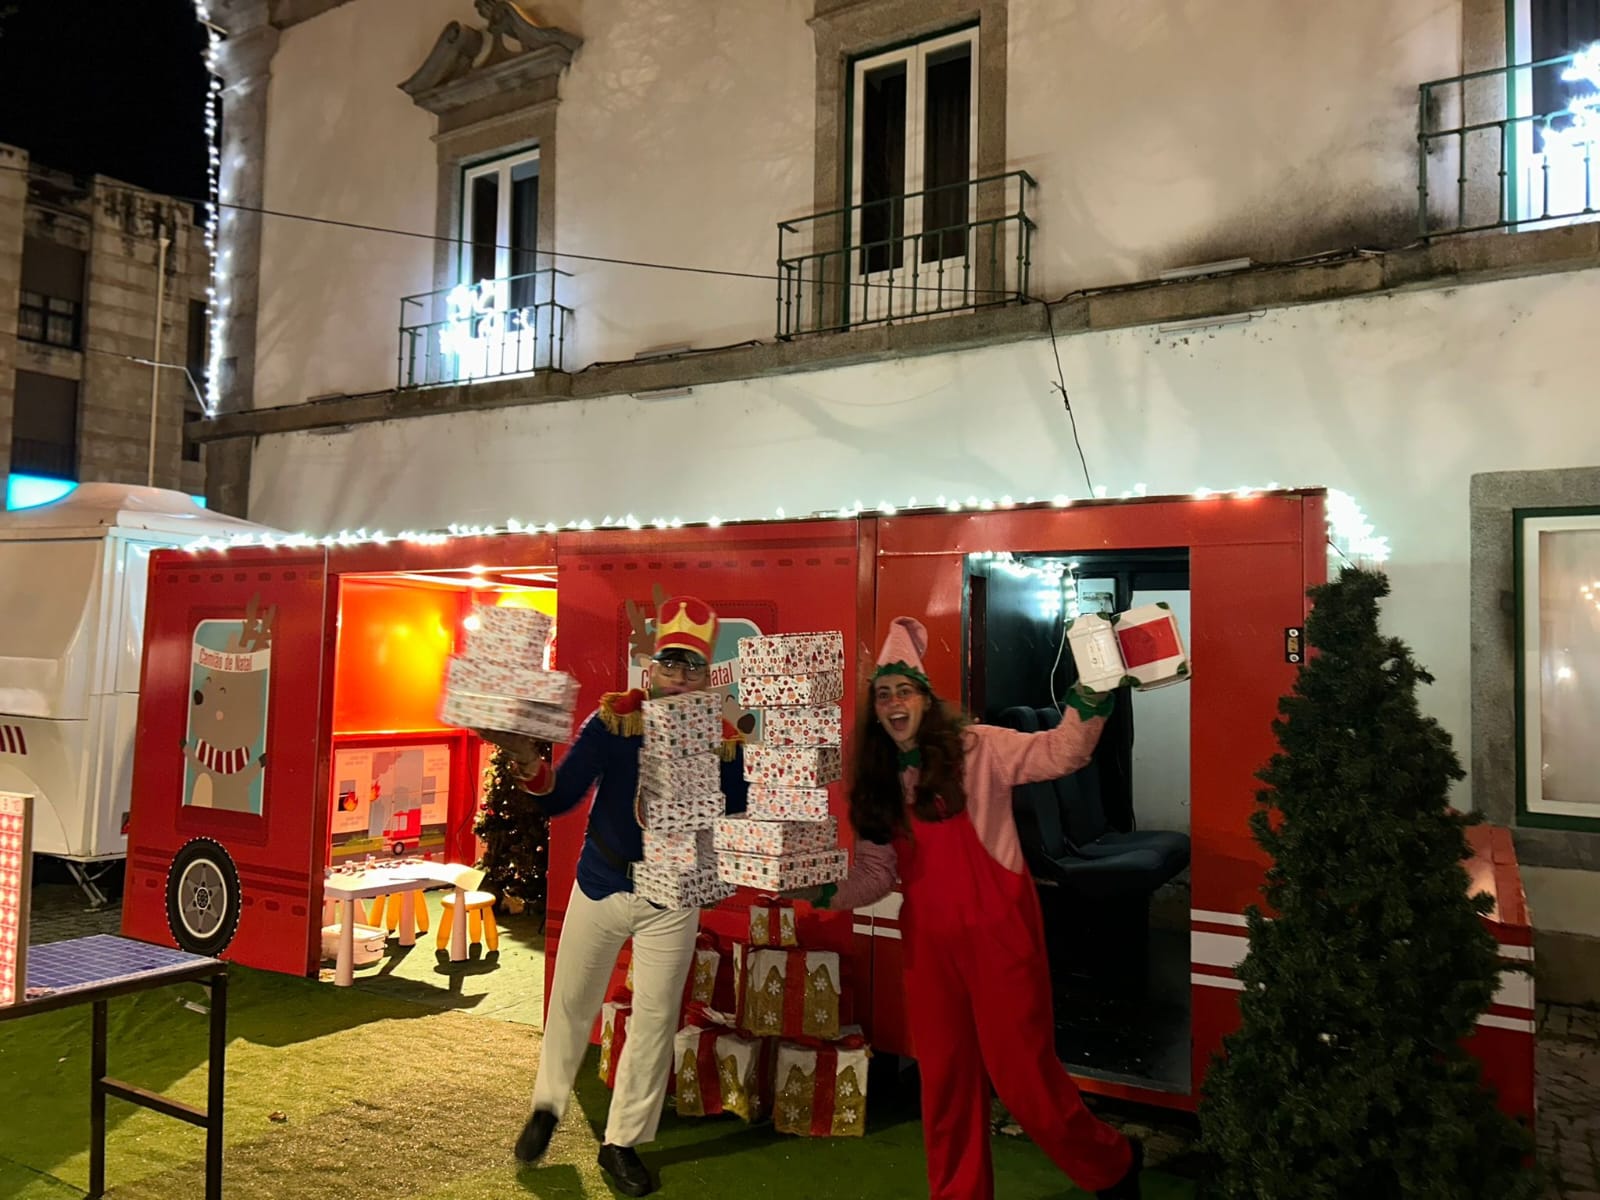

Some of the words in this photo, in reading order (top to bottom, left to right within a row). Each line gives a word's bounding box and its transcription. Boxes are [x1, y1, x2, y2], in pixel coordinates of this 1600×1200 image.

[224, 654, 233, 671] de
[235, 654, 253, 671] Natal
[709, 662, 733, 687] atal
